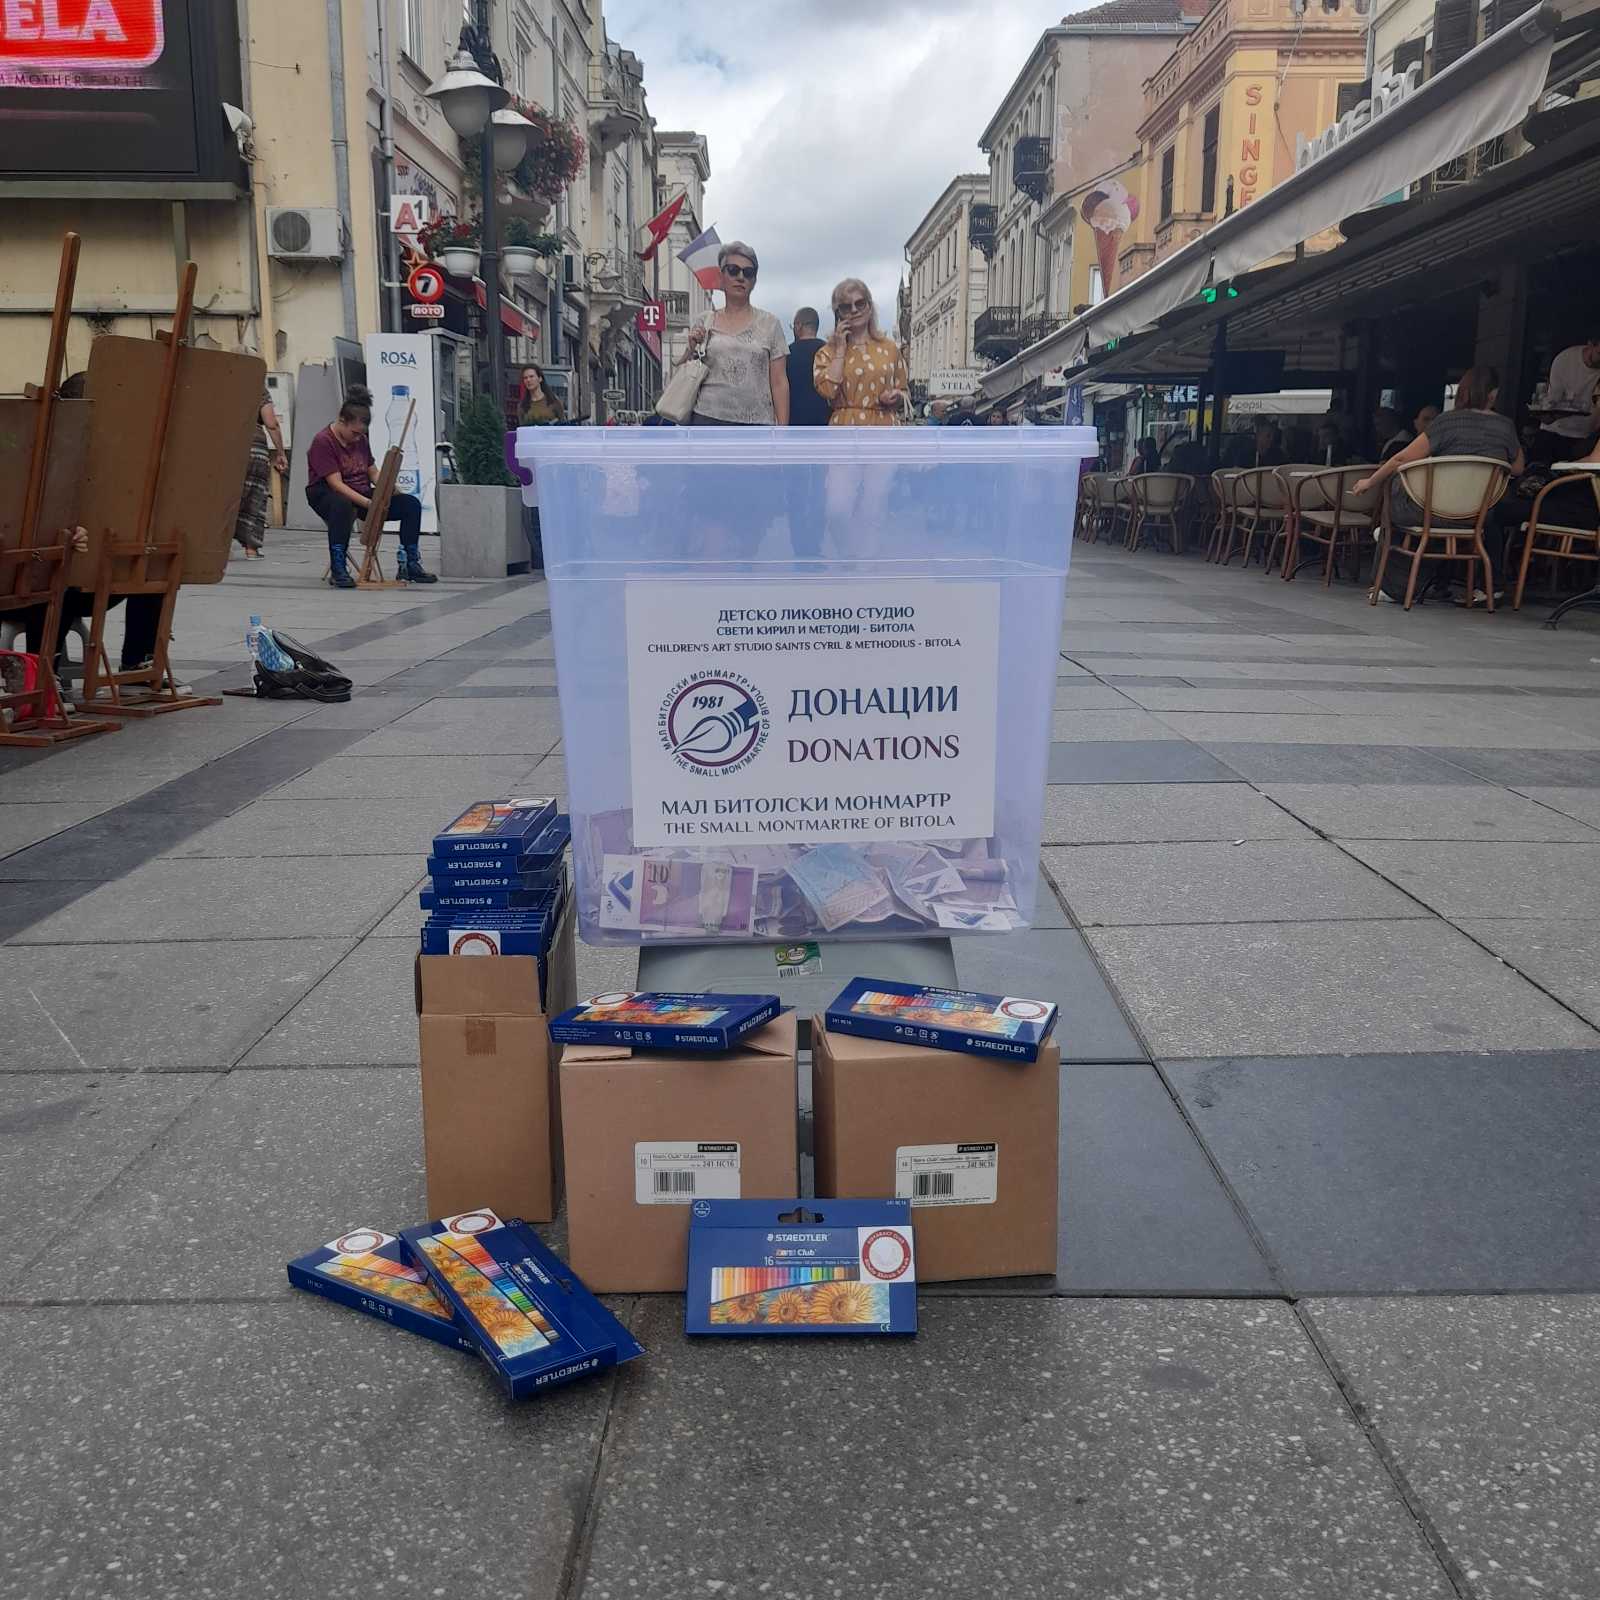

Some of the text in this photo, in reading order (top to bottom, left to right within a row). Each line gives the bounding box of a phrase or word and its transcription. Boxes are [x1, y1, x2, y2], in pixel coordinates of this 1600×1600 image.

[0, 0, 128, 41] ELA
[417, 276, 432, 293] 7
[643, 305, 659, 326] T
[381, 352, 417, 365] ROSA
[941, 381, 972, 391] STELA
[398, 476, 416, 484] OSA
[718, 606, 914, 623] ДЕТСКО ЛИКОВНО СТУДИО
[716, 625, 754, 636] СВЕТИ
[756, 625, 796, 636] КИРИЛ
[798, 624, 806, 634] И
[870, 622, 914, 633] БИТОЛА
[648, 642, 710, 654] CHILDREN'S
[711, 642, 732, 652] ART
[734, 641, 772, 652] STUDIO
[775, 640, 811, 650] SAINTS
[814, 640, 844, 650] CYRIL
[845, 640, 853, 650] &
[854, 638, 916, 649] METHODIUS
[924, 638, 961, 648] BITOLA
[690, 669, 749, 686] МОНМАРТР
[692, 695, 724, 710] 1981
[788, 685, 959, 722] ДОНАЦИИ
[788, 734, 960, 764] DONATIONS
[673, 752, 690, 770] THE
[689, 764, 720, 778] SMALL
[662, 793, 952, 816] МАЛ БИТОЛСКИ МОНМАРТР
[664, 814, 956, 835] THE SMALL MONTMARTRE OF BITOLA
[454, 842, 500, 850] STAEDTLER
[454, 878, 501, 886] STAEDTLER
[680, 1035, 718, 1043] STAEDTLER
[974, 1039, 1026, 1054] STAEDTLER
[775, 1233, 829, 1242] STAEDTLER
[798, 1248, 816, 1256] Club
[764, 1256, 774, 1266] 16
[535, 1360, 589, 1386] STAEDTLER
